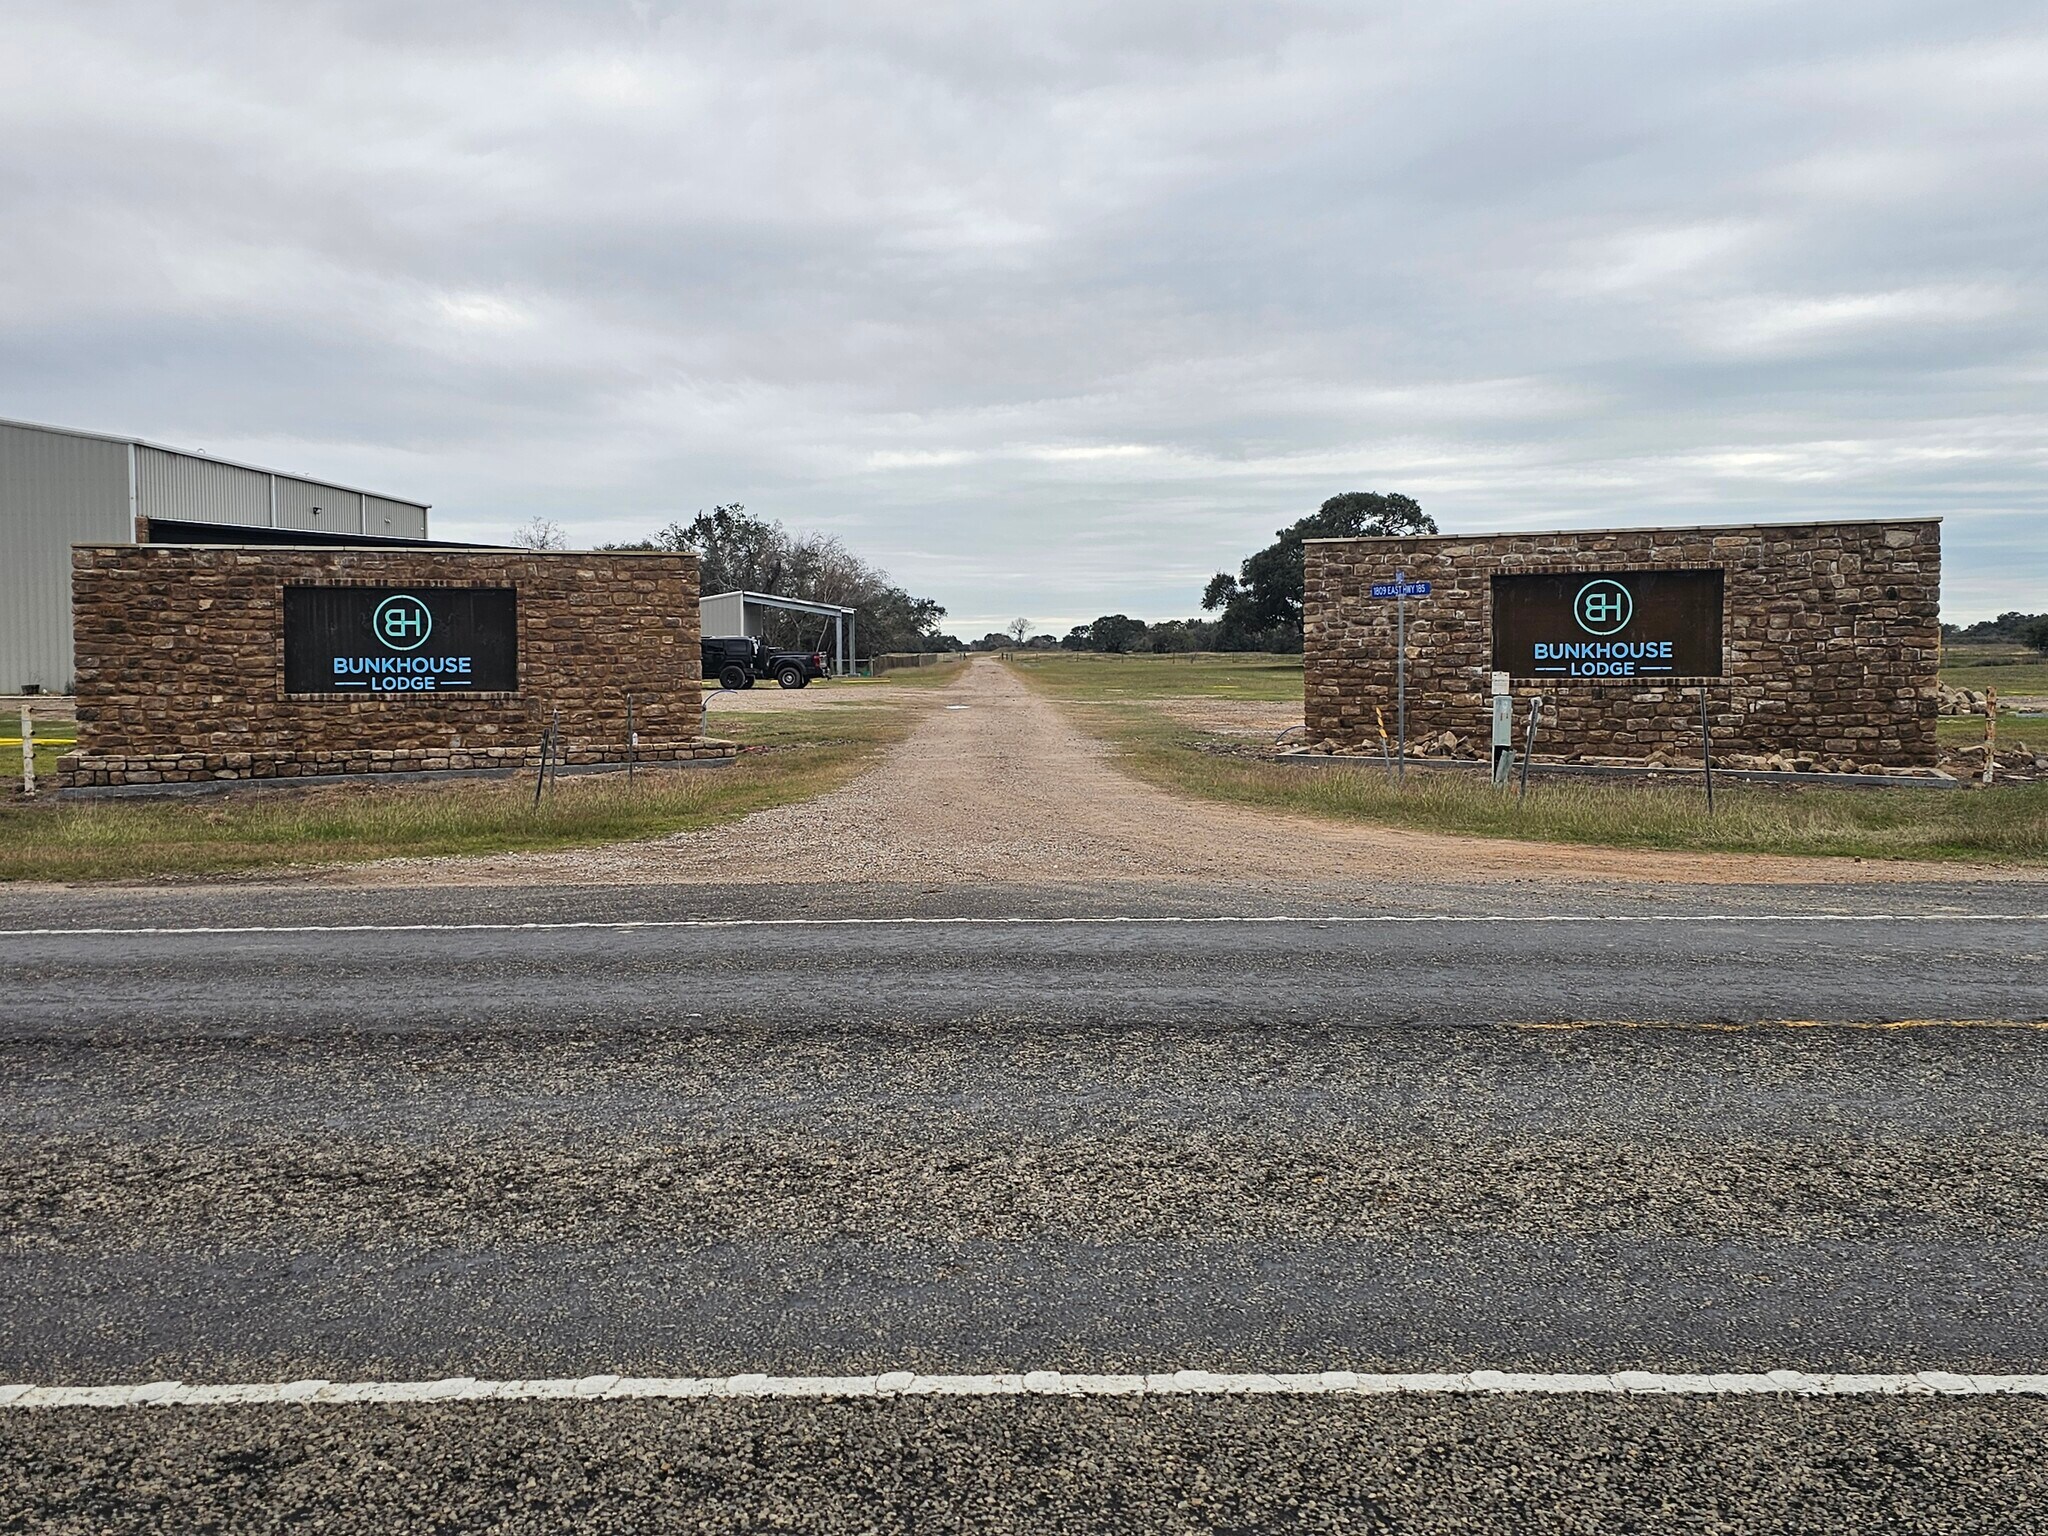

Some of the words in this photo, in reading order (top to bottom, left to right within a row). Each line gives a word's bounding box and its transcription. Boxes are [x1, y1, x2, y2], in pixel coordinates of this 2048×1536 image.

[1373, 586, 1387, 596] 1809
[1387, 586, 1402, 595] EAST
[1402, 585, 1415, 594] HWY
[1416, 584, 1426, 593] 185
[1534, 641, 1673, 660] BUNKHOUSE
[333, 656, 472, 674] BUNKHOUSE
[1570, 661, 1636, 676] LODGE
[371, 676, 436, 691] LODGE
